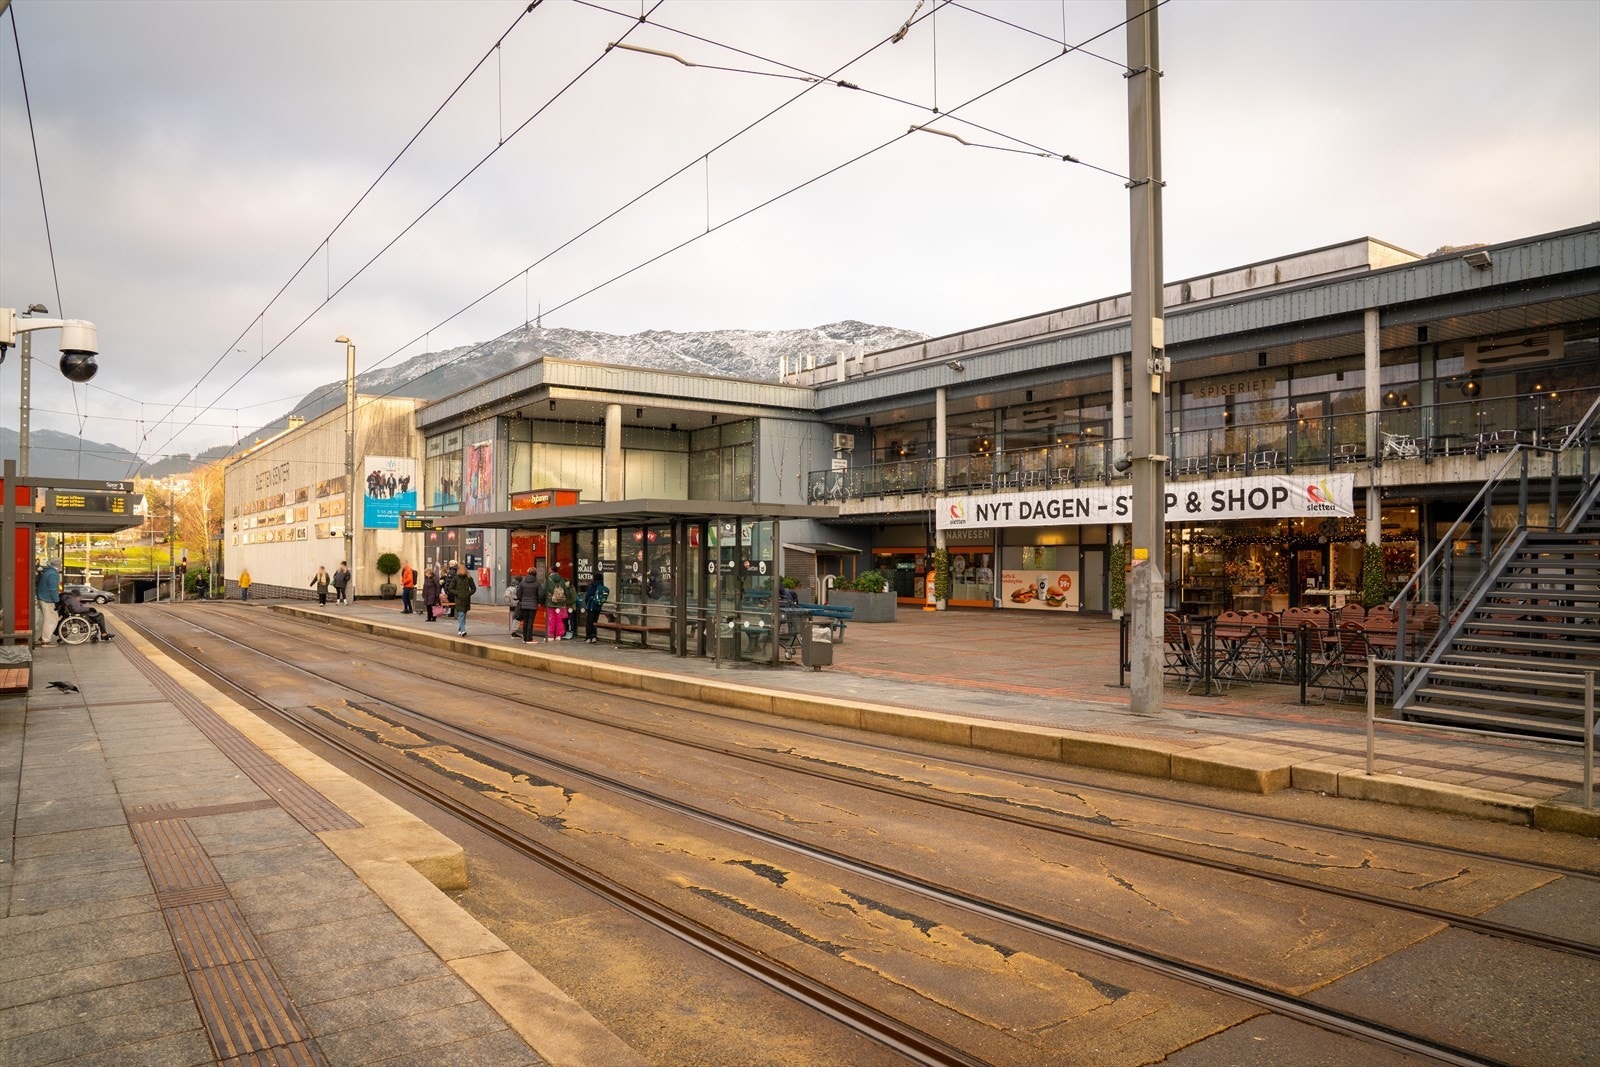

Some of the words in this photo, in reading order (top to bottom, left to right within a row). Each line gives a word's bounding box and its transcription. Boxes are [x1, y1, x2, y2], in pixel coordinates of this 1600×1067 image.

[976, 502, 1012, 521] NYT
[1020, 497, 1089, 520] DAGEN
[1115, 493, 1177, 516] SP
[1186, 491, 1202, 513] &
[1211, 486, 1288, 512] SHOP
[1306, 503, 1335, 511] sletten
[946, 529, 990, 540] NARVESEN
